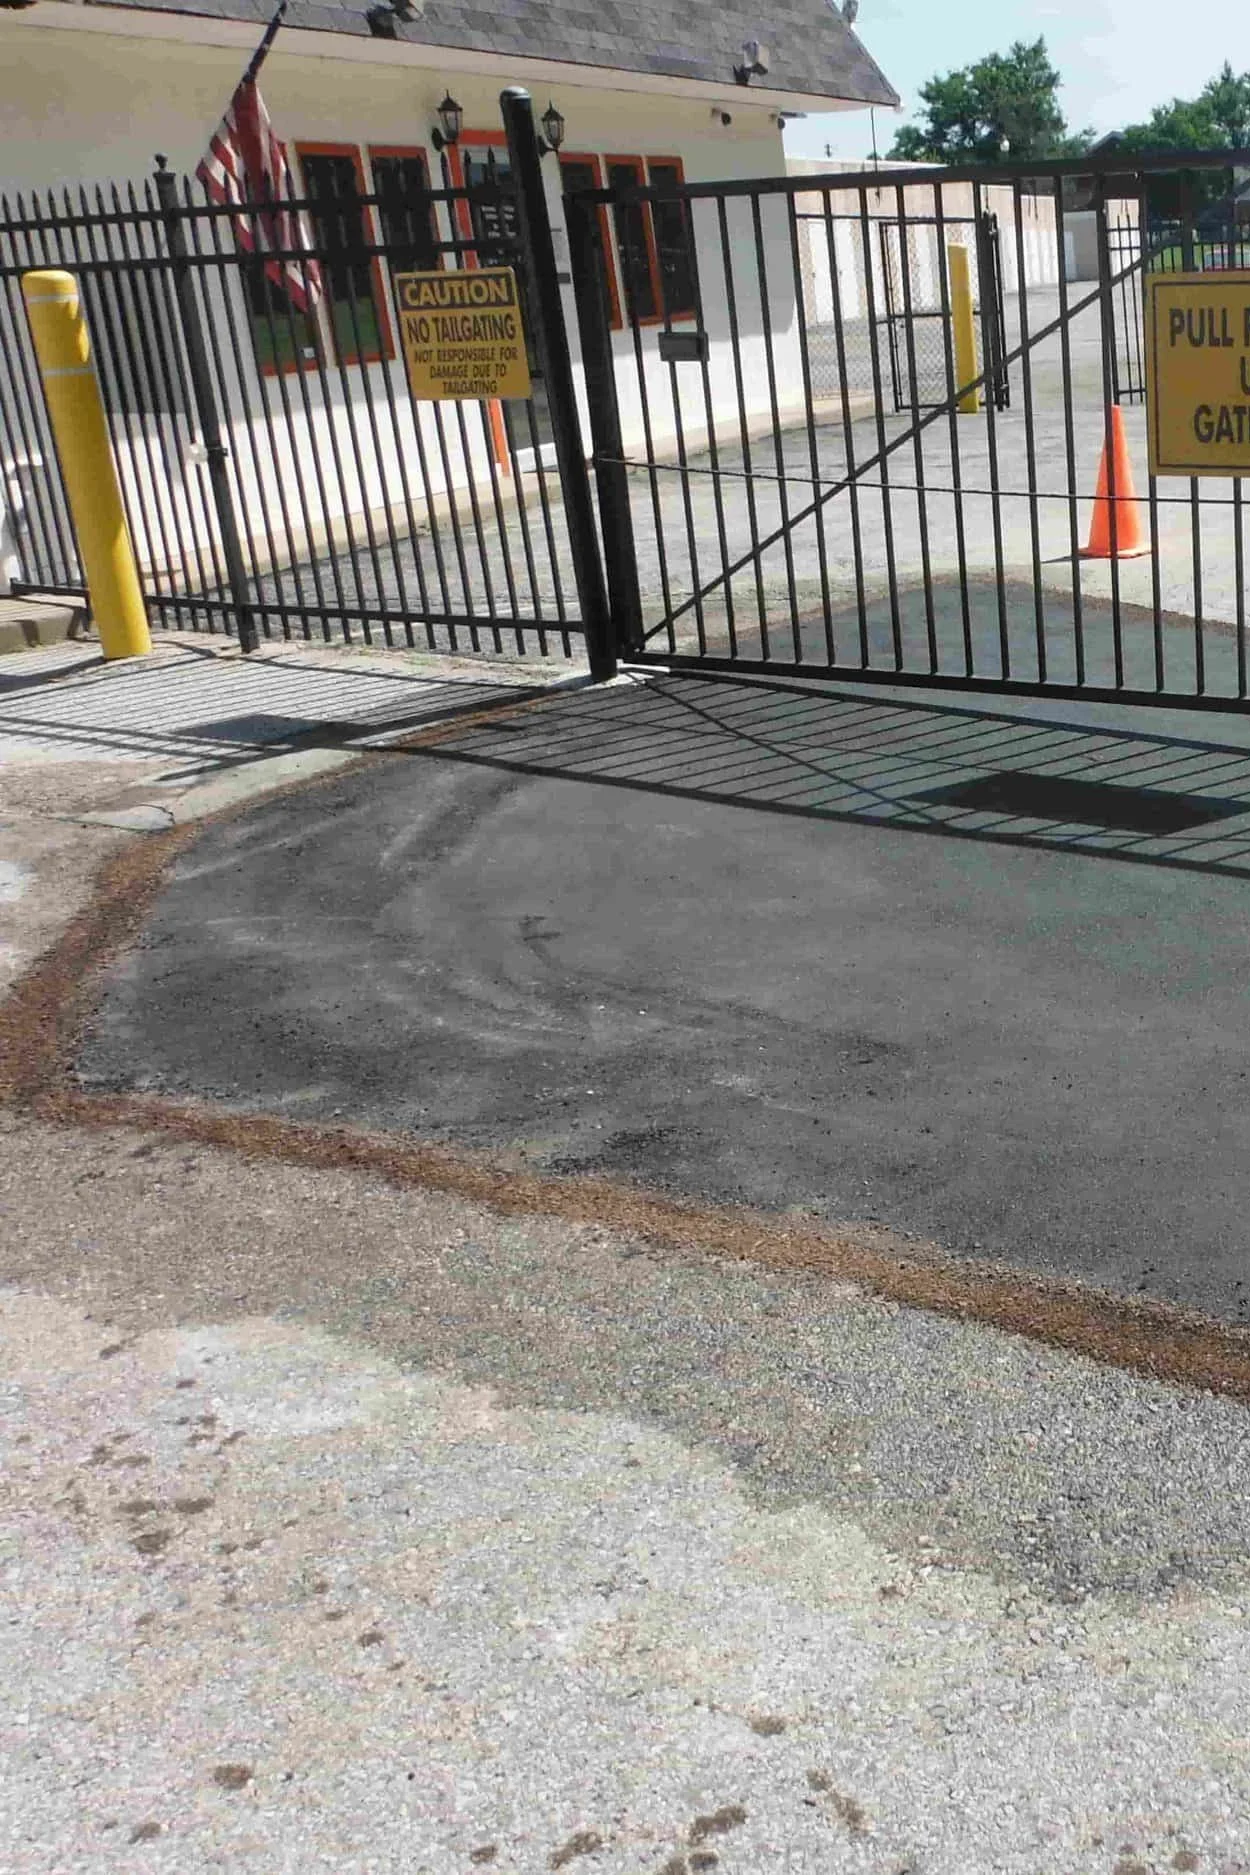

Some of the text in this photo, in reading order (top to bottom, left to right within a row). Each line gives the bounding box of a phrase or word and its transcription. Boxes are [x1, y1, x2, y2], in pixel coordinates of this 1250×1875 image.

[405, 279, 509, 306] CAUTION
[407, 313, 516, 344] NO TAILGATING
[1169, 307, 1234, 347] PULL
[415, 346, 518, 363] NOT RESPONSIBLE FOR
[430, 363, 507, 379] DAMAGE DUE TO
[442, 380, 498, 394] TAILGATING
